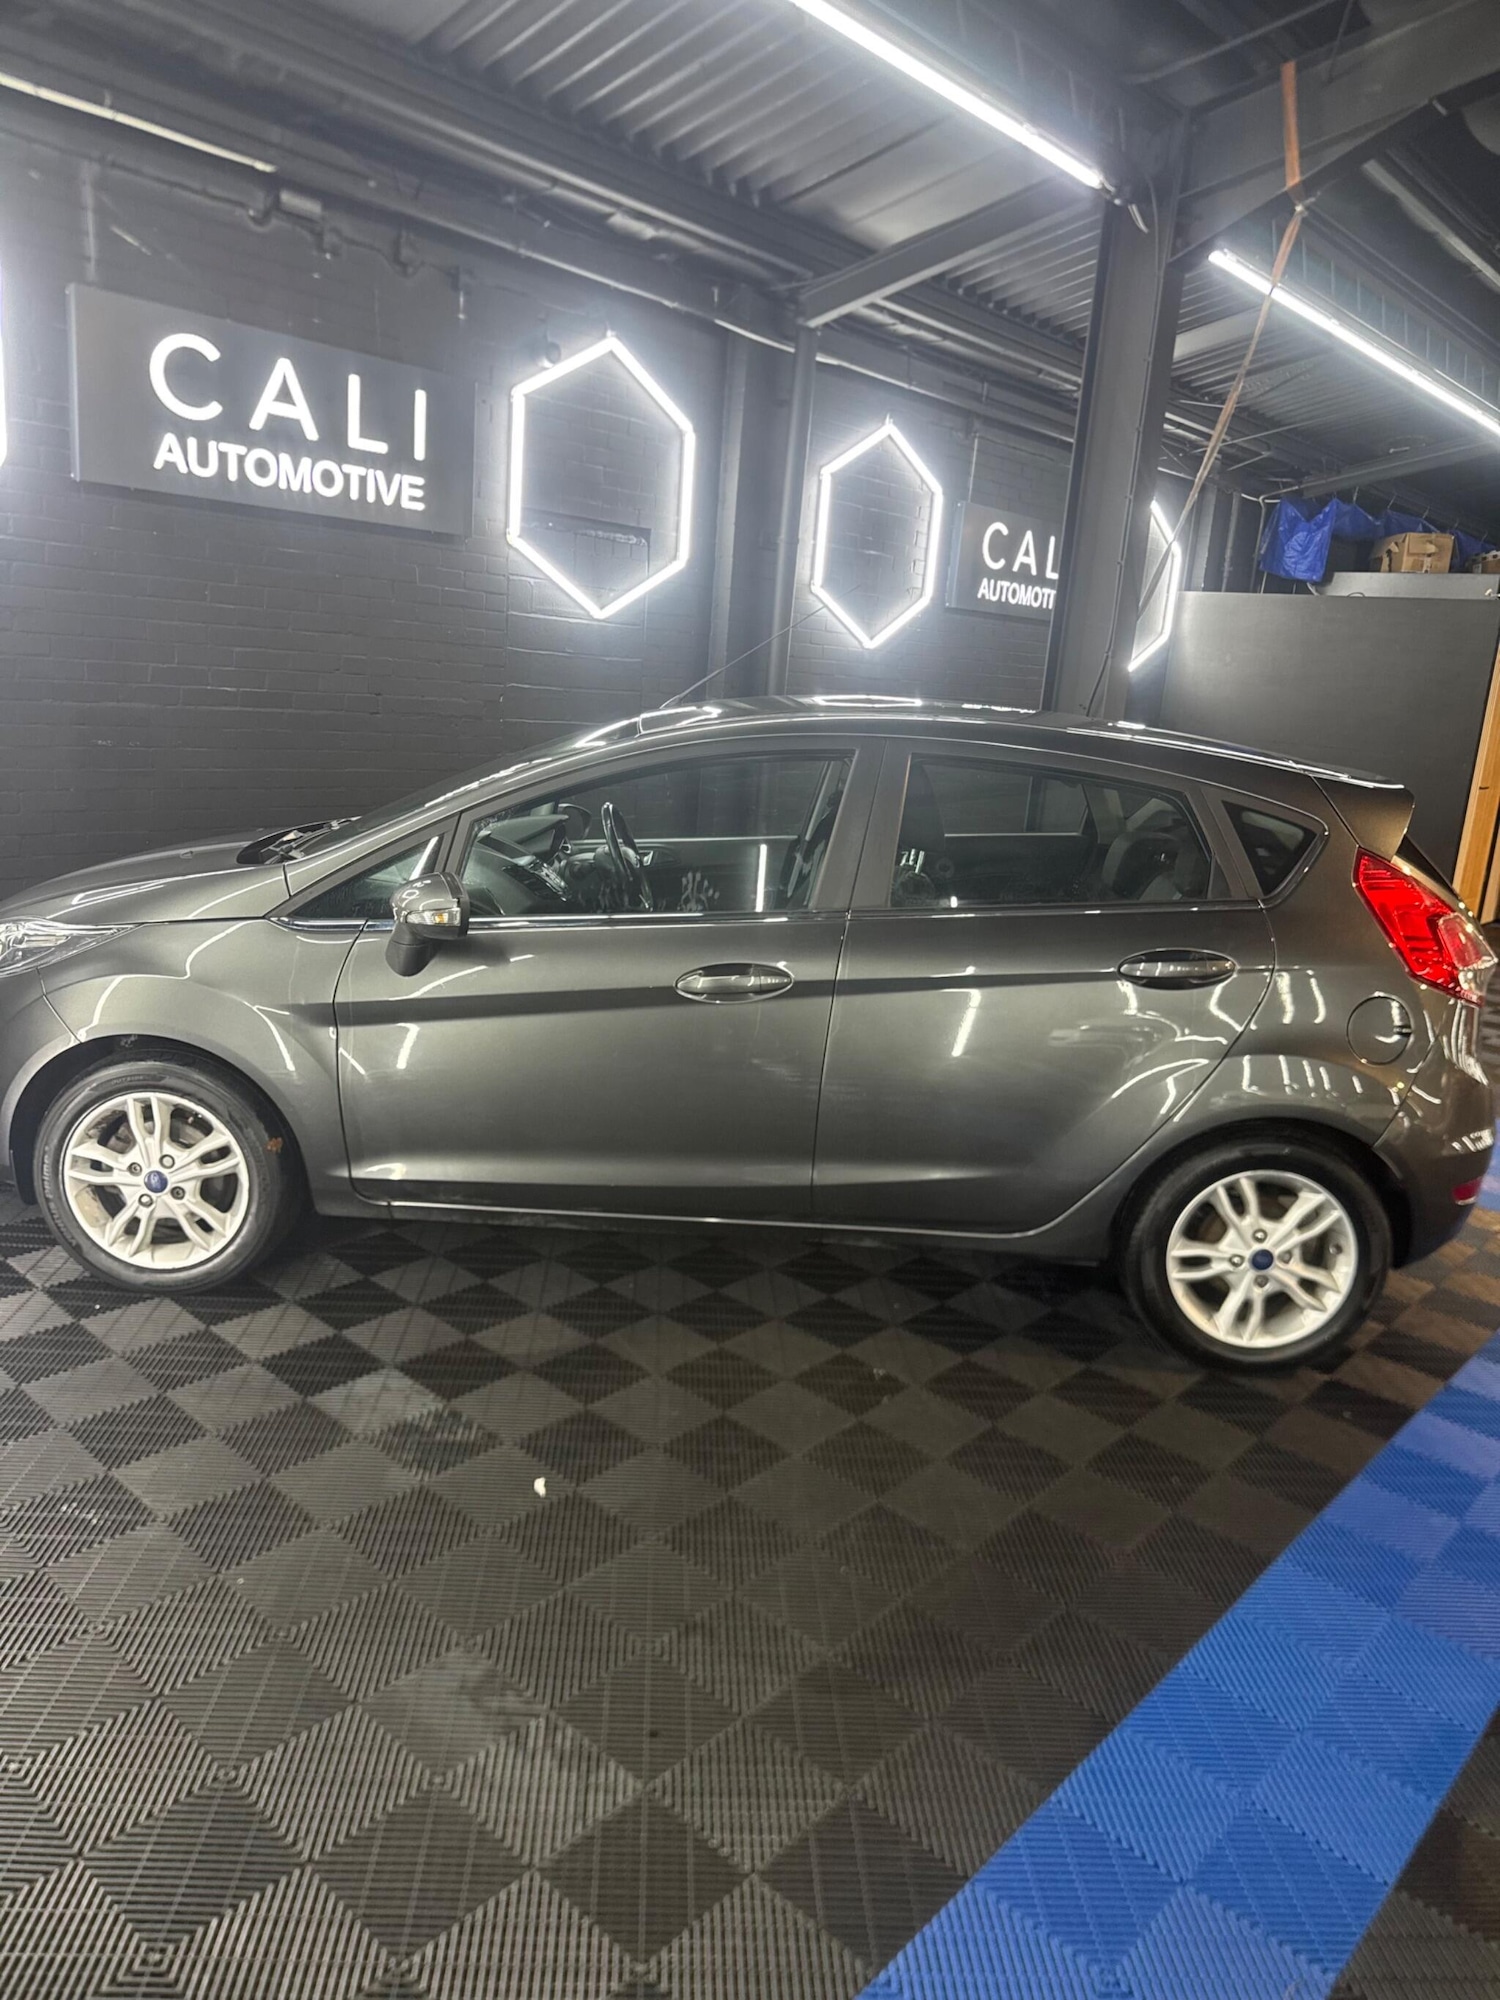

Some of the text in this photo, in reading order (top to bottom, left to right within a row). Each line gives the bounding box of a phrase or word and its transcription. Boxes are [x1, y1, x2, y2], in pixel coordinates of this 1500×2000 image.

[149, 333, 427, 461] CALI
[153, 432, 426, 511] AUTOMOTIVE
[982, 521, 1059, 580] CAL
[977, 577, 1056, 610] AUTOMOTI
